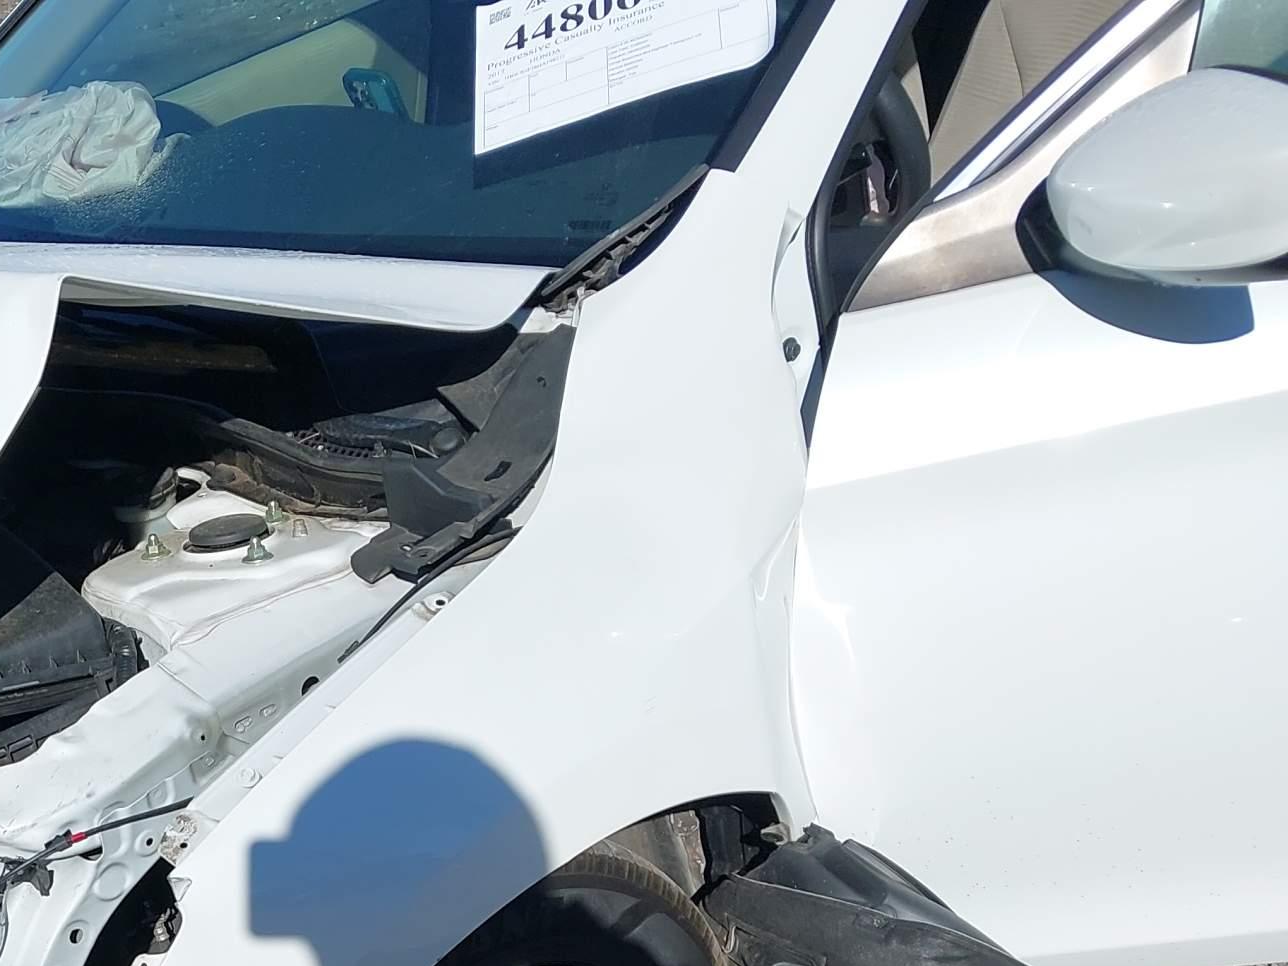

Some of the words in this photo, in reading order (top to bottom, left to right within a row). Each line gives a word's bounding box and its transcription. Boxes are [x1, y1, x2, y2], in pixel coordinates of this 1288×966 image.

[487, 42, 551, 72] Progressive
[555, 23, 603, 45] Casualty
[608, 1, 665, 26] Insurance
[529, 48, 561, 65] HONDA
[614, 15, 653, 33] ACCORD
